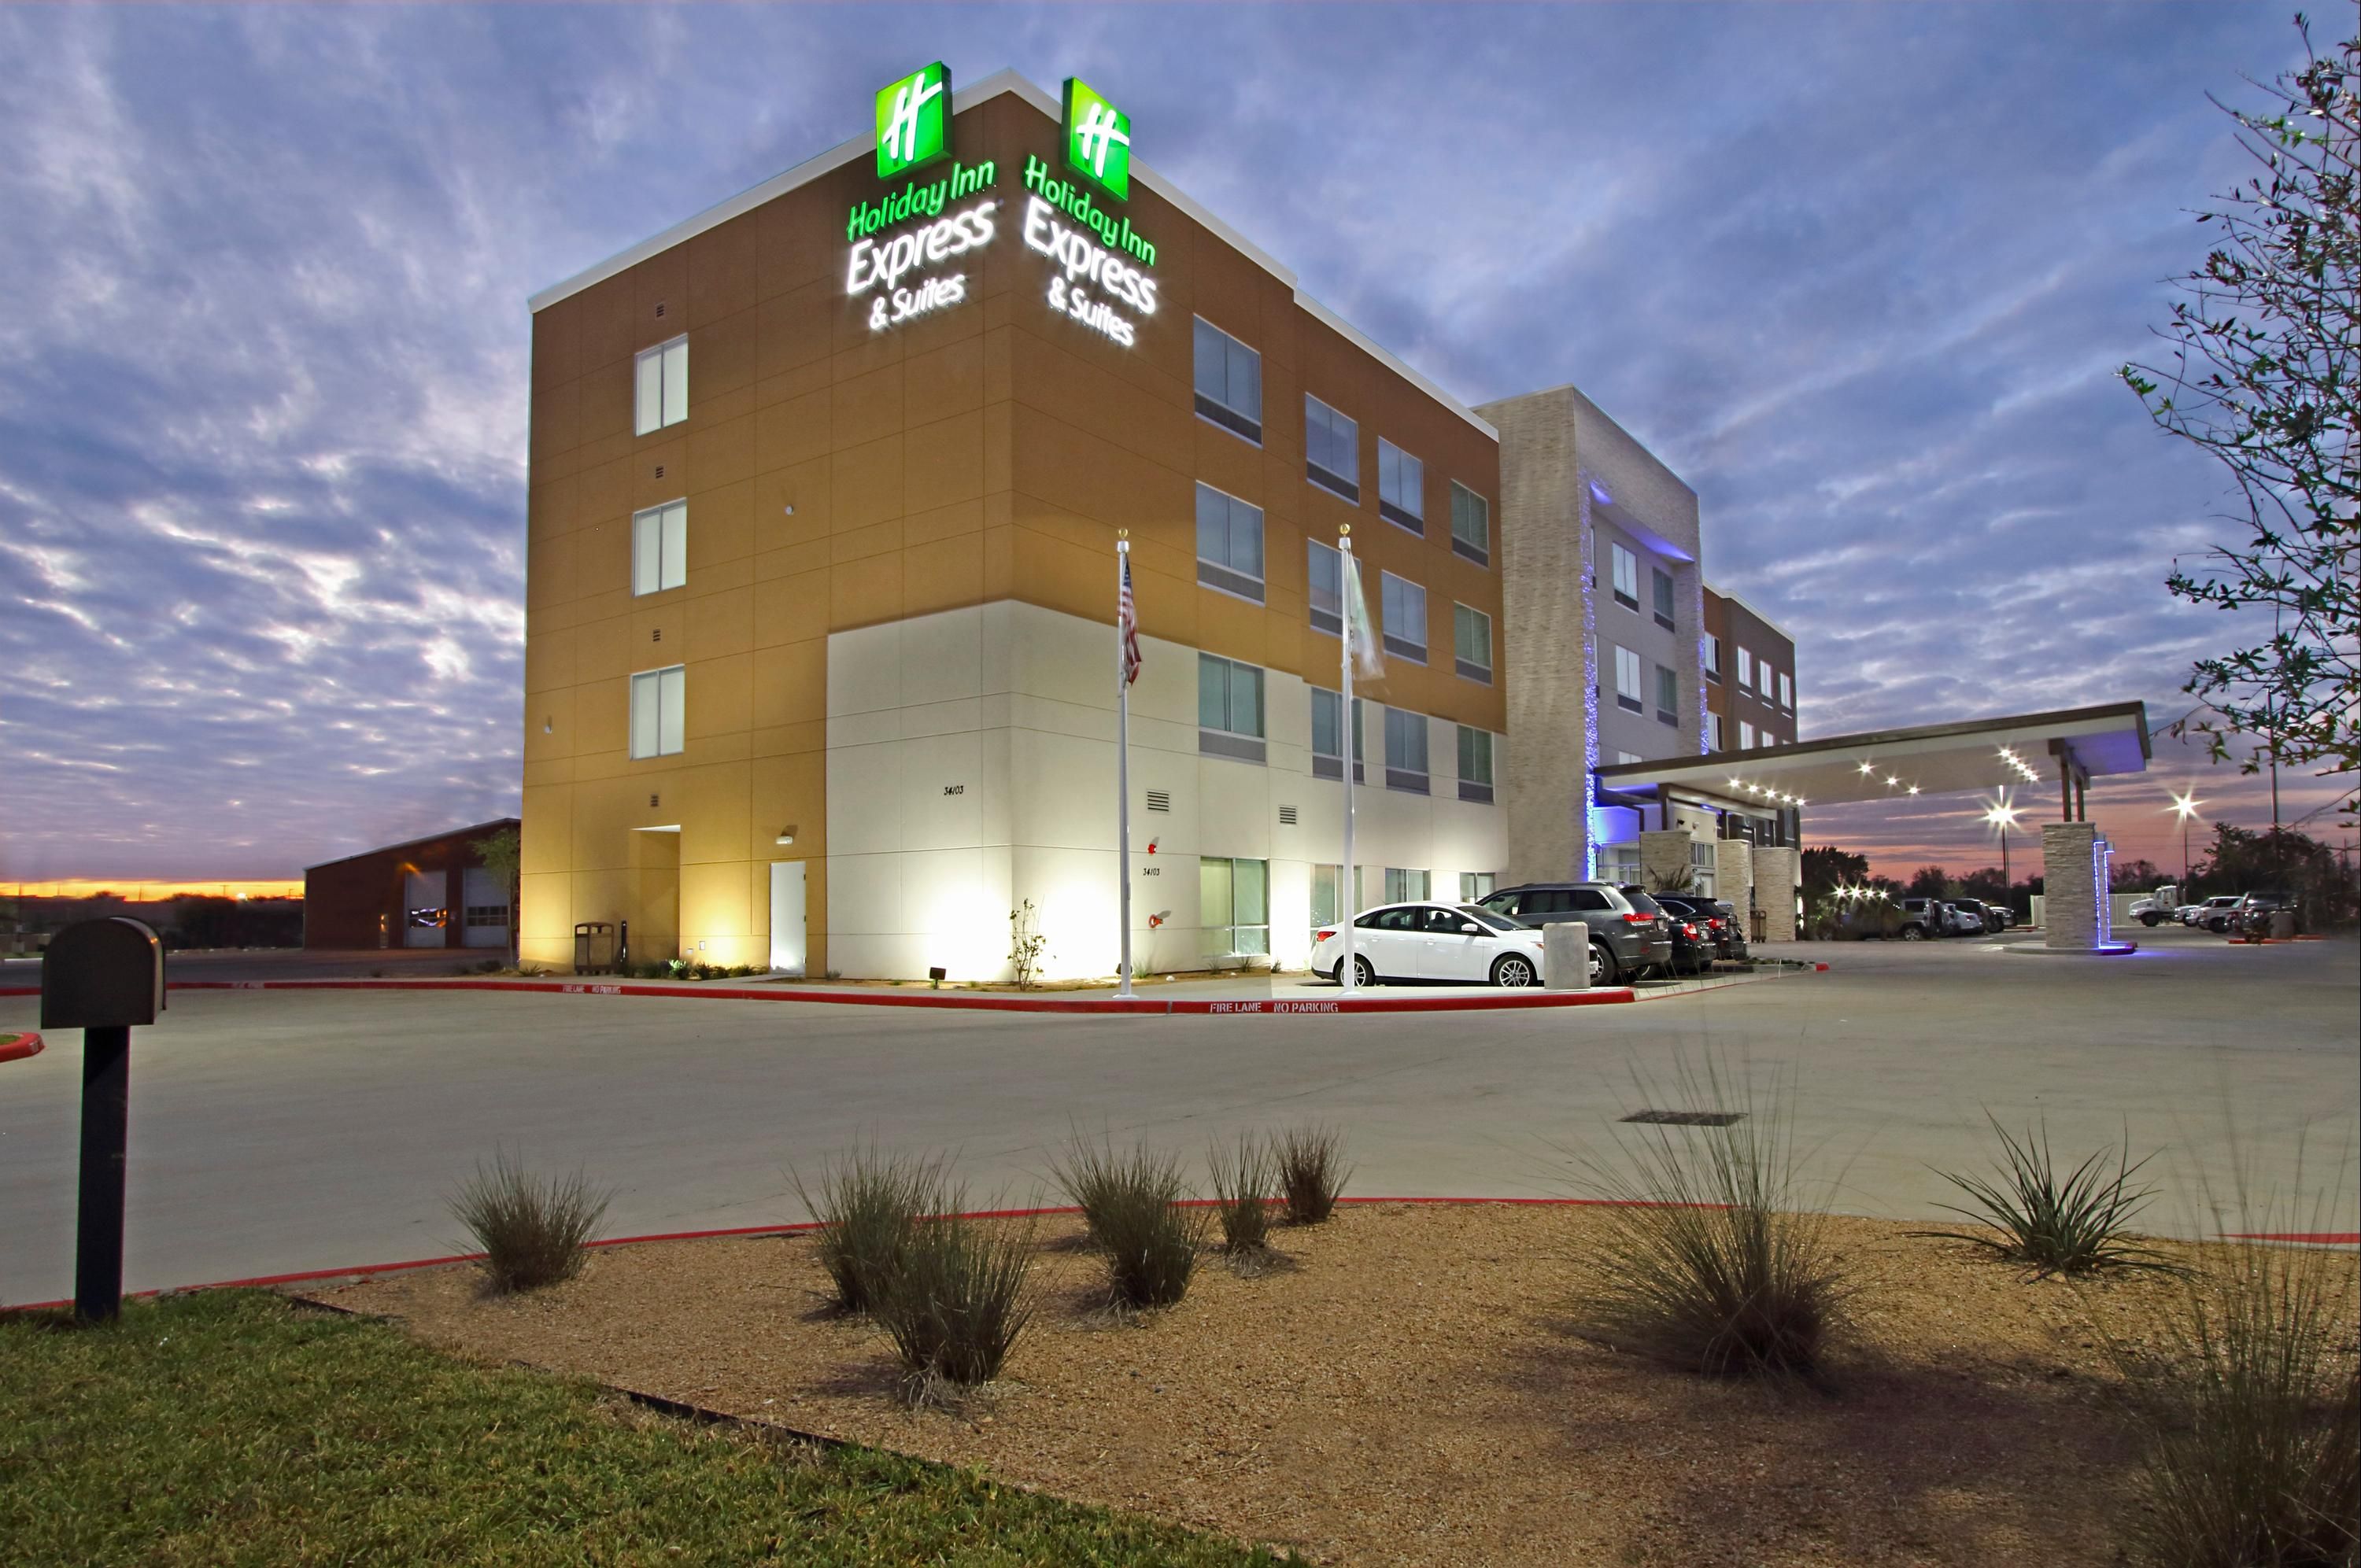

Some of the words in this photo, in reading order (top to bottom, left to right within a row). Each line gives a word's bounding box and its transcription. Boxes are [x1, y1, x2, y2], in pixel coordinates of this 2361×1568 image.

[848, 181, 948, 242] Holiday
[950, 160, 996, 200] Inn
[1024, 154, 1119, 248] Holiday
[1121, 216, 1156, 266] Inn
[847, 201, 996, 294] Express
[1024, 196, 1158, 315] Express
[870, 297, 889, 330] &
[891, 274, 966, 323] Suites
[1047, 276, 1067, 312] &
[1068, 287, 1135, 347] Suites
[1210, 1002, 1232, 1013] FIRE
[1235, 1002, 1262, 1013] LANE
[1273, 1002, 1289, 1013] NO
[1291, 1002, 1338, 1013] PARKING
